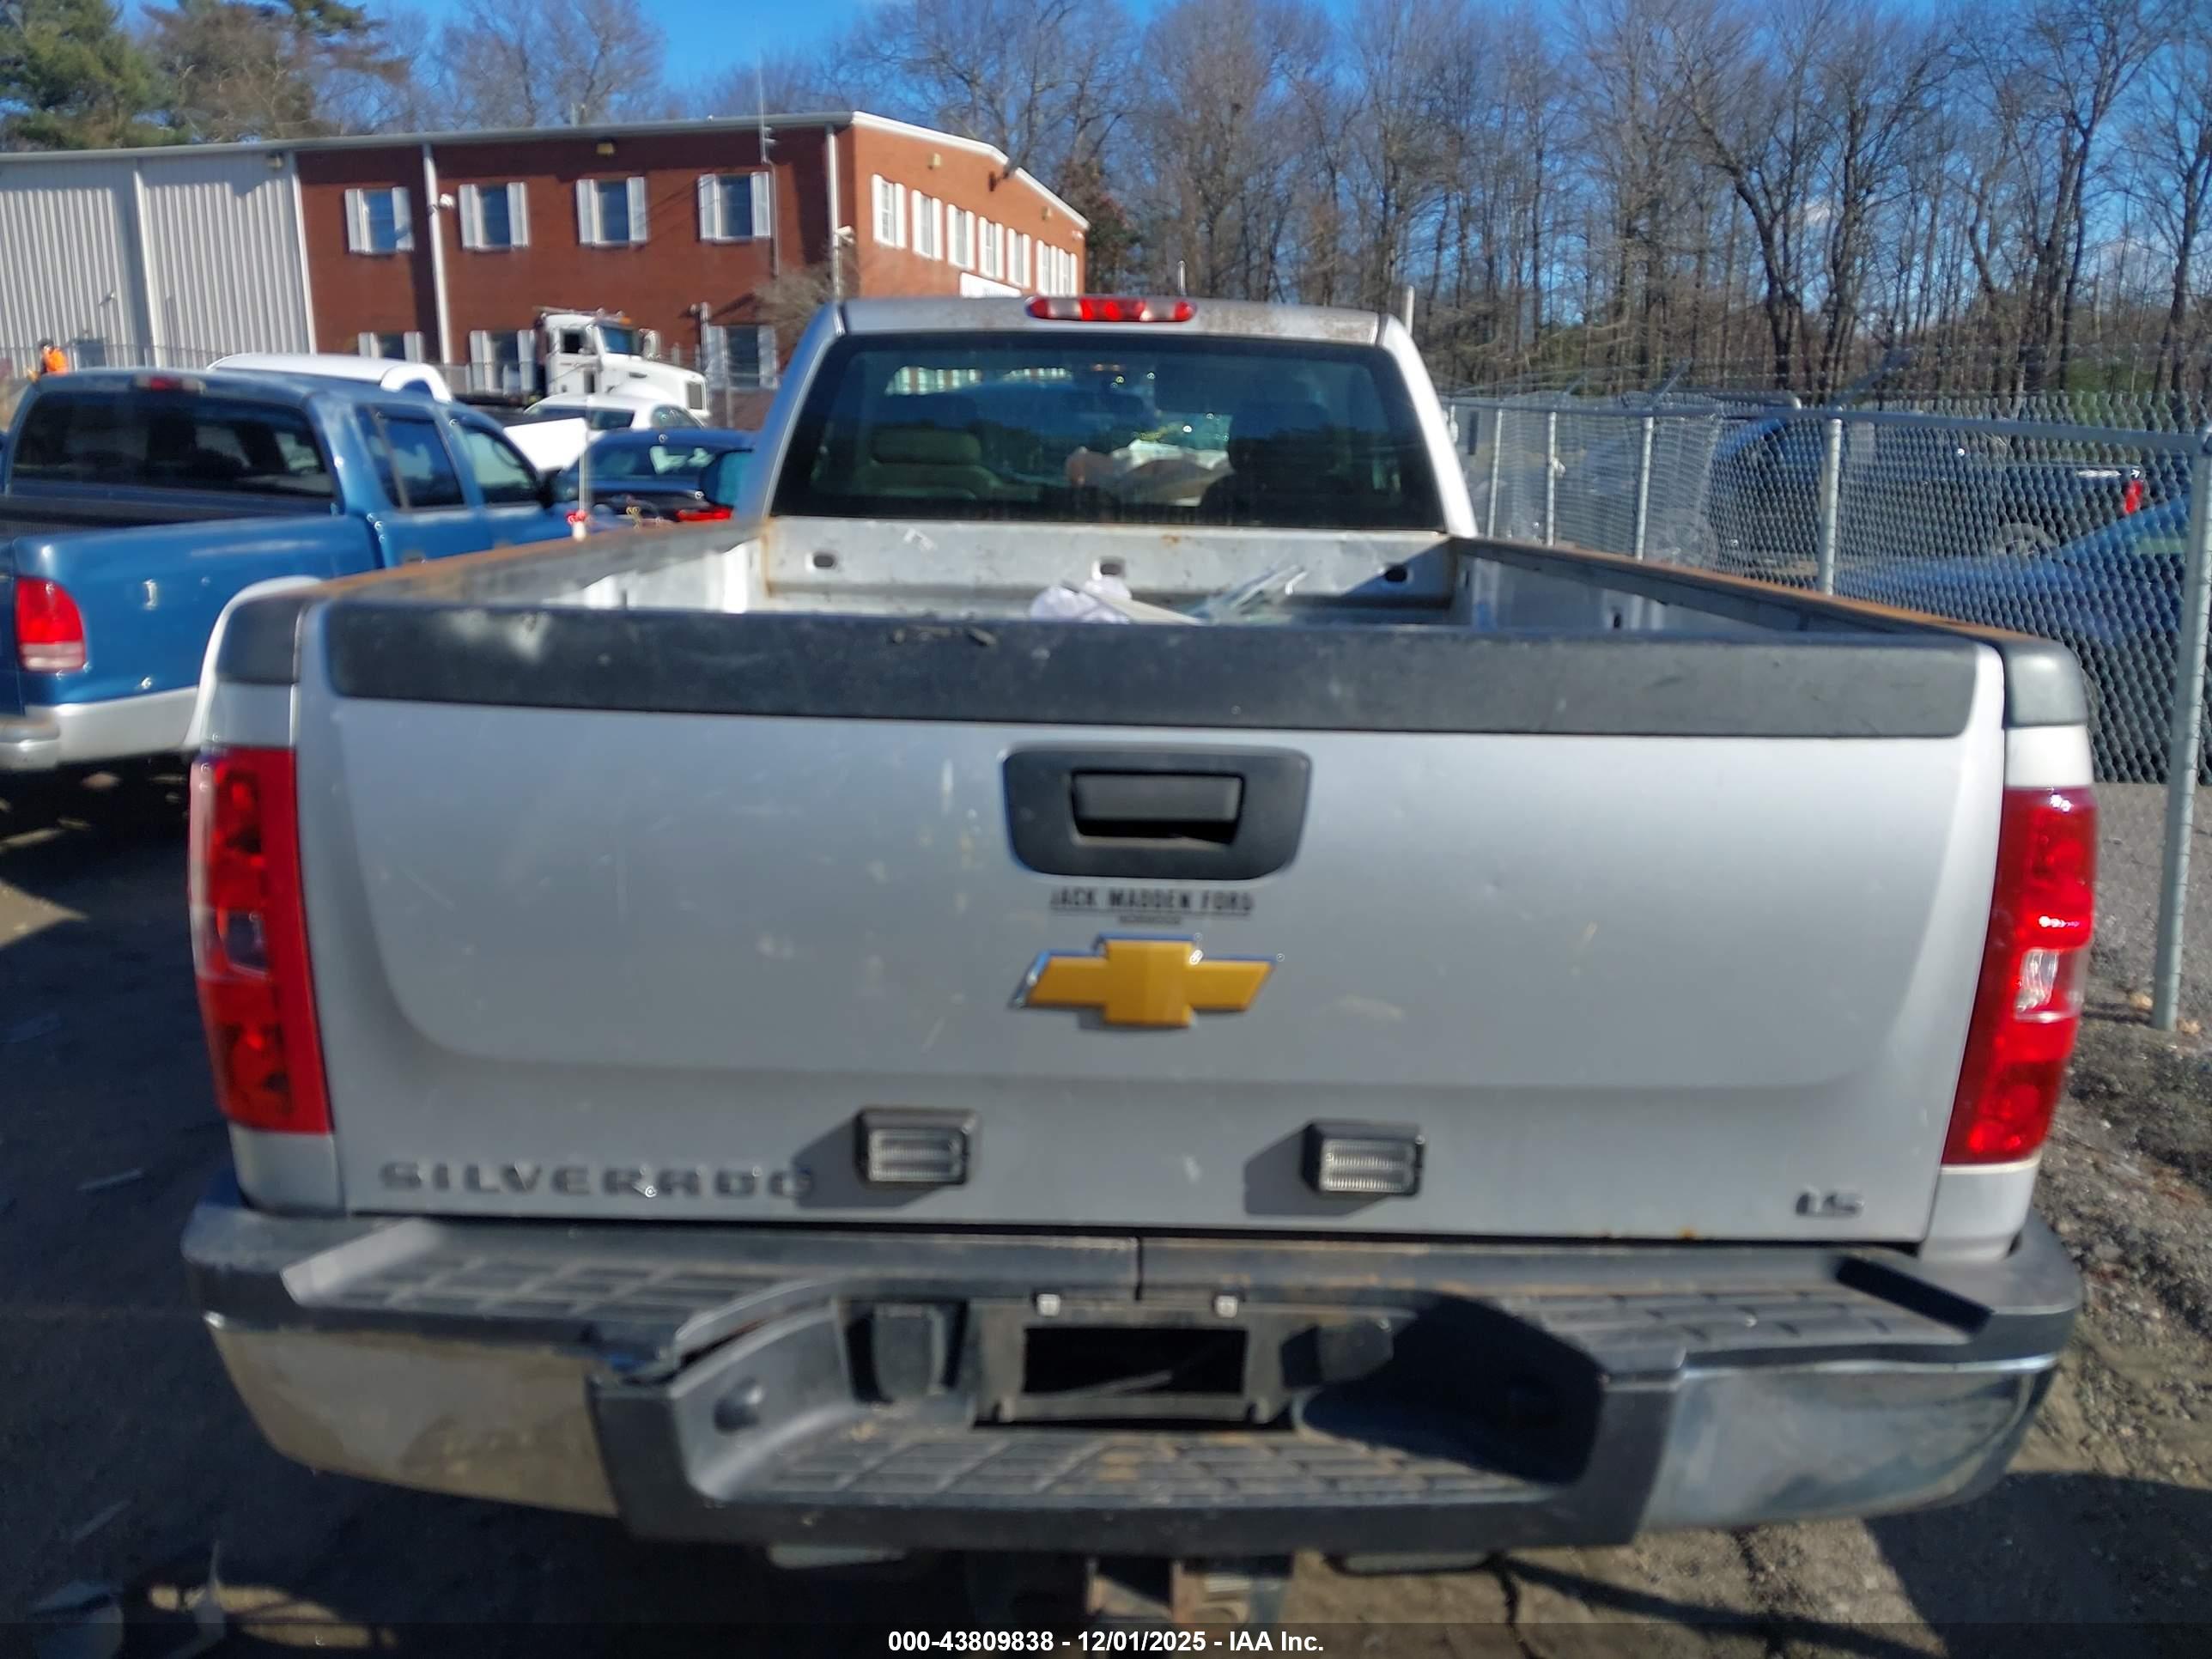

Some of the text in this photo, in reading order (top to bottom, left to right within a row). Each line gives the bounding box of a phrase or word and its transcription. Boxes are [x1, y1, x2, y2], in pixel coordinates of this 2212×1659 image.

[1050, 886, 1255, 912] JACK MADDEN FORD
[379, 1160, 815, 1199] SILVERADO
